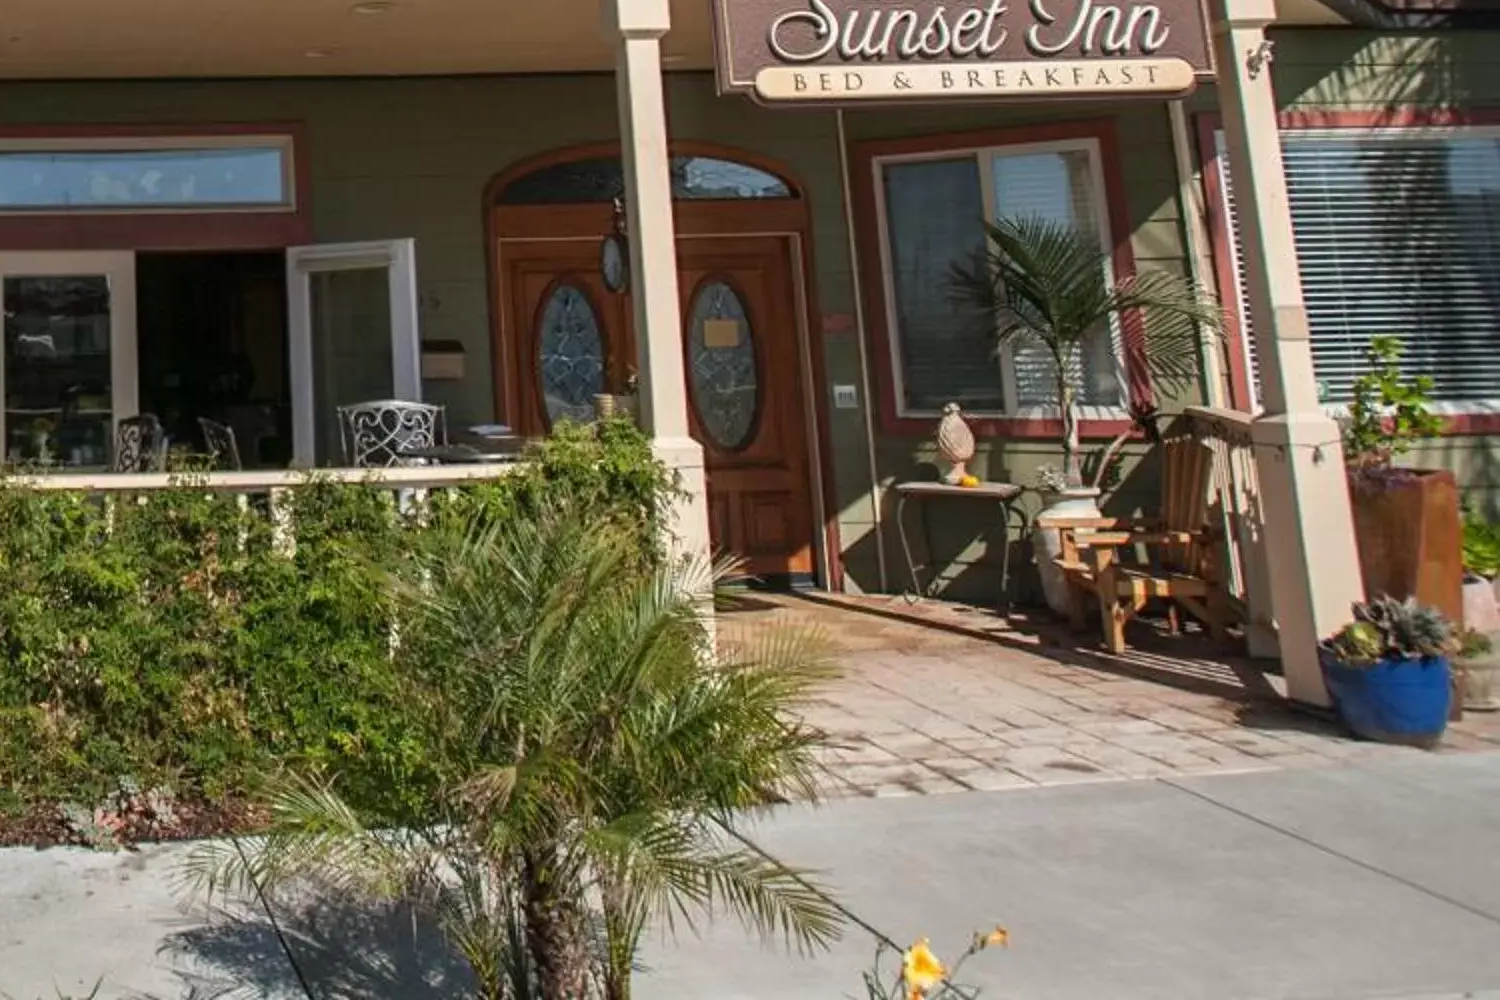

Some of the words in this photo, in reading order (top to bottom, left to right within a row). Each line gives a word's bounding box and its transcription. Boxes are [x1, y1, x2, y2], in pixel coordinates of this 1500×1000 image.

[793, 71, 864, 92] BED
[893, 70, 913, 90] &
[941, 65, 1160, 89] BREAKFAST
